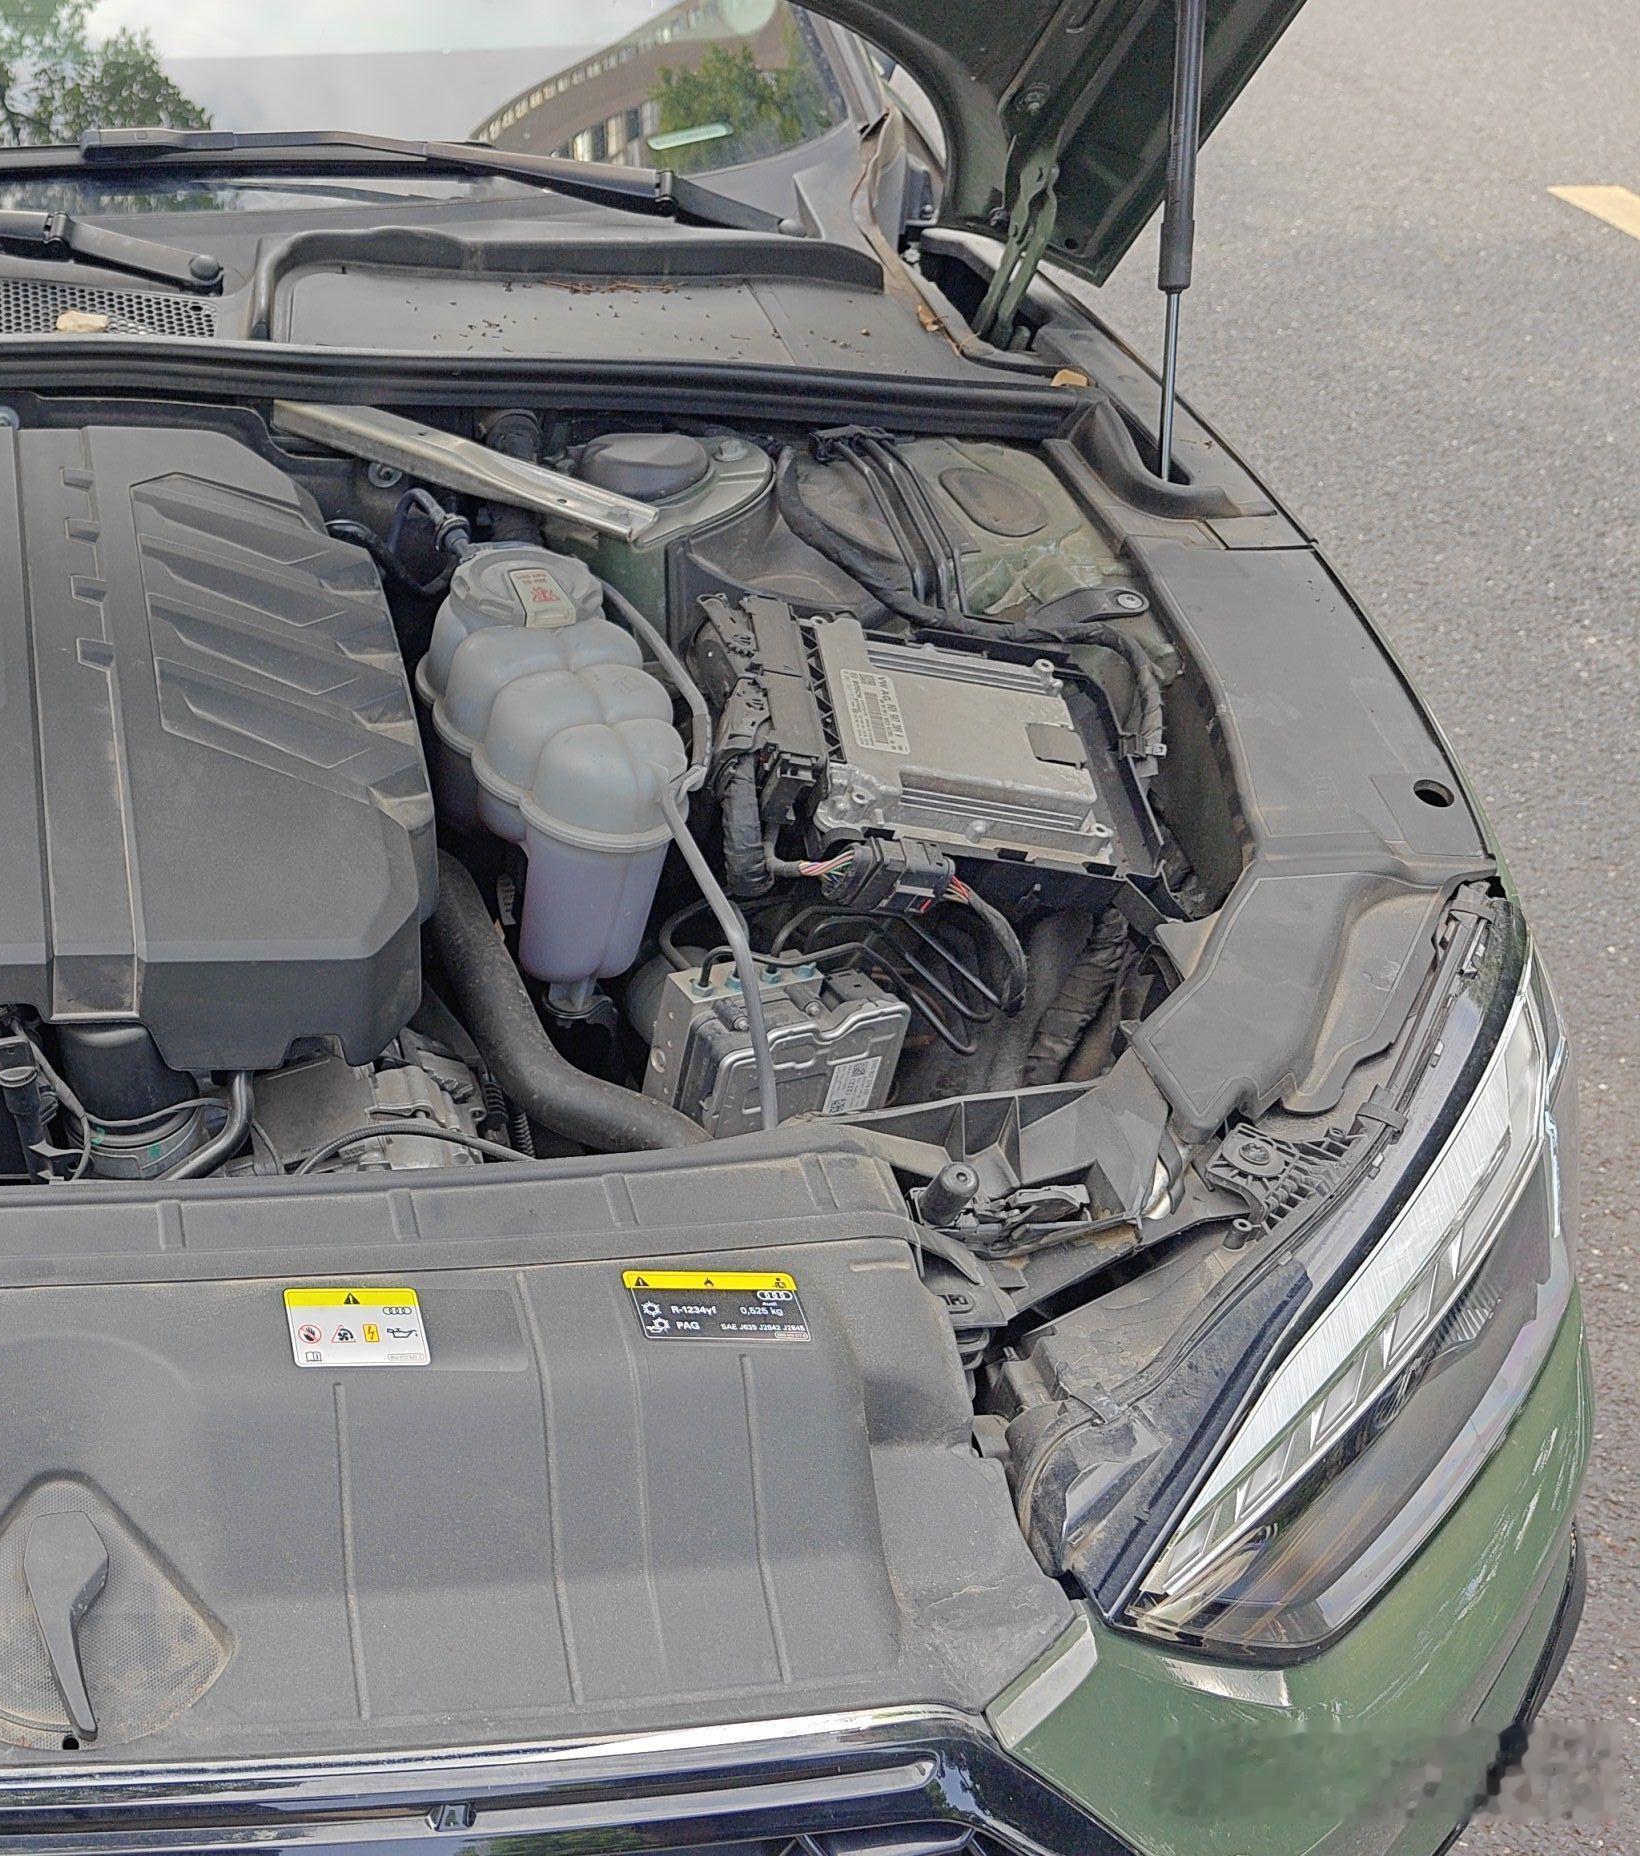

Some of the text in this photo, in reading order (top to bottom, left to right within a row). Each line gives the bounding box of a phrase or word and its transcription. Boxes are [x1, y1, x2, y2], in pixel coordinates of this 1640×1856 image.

[670, 1305, 717, 1316] R-1234yf
[770, 1307, 784, 1316] kg
[676, 1321, 700, 1330] PAG
